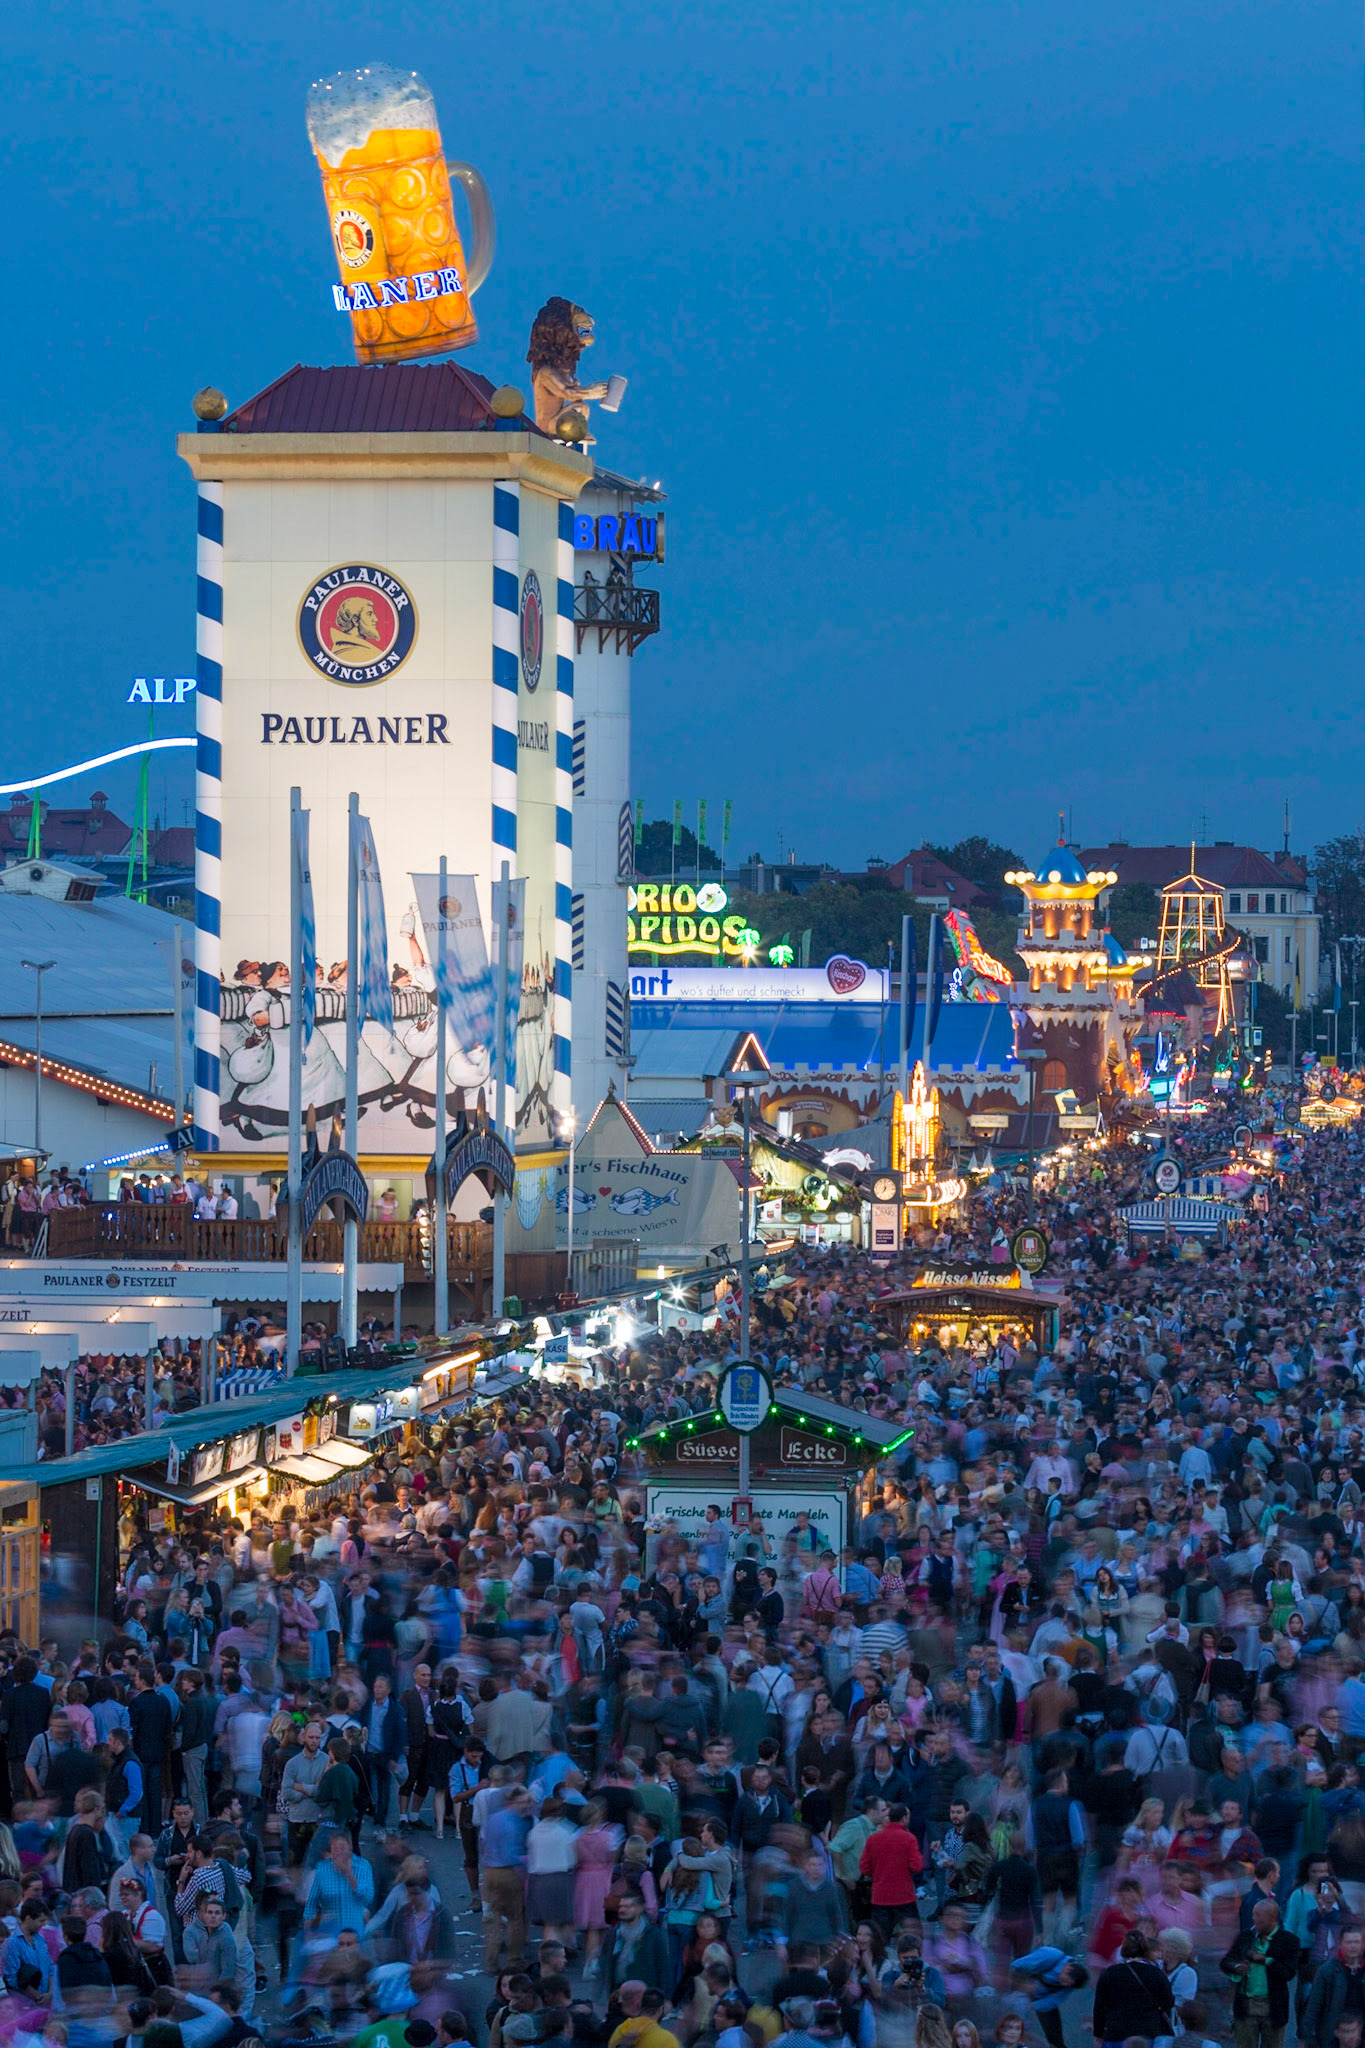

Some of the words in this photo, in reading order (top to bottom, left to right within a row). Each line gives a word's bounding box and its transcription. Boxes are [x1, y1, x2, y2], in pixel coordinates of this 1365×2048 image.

[574, 512, 657, 554] BRÄU
[304, 567, 409, 612] PAULANER
[313, 650, 401, 681] MÜNCHEN
[126, 678, 198, 703] ALP
[261, 713, 452, 745] PAULANER
[636, 883, 697, 913] RIO
[631, 969, 673, 996] art
[680, 985, 703, 997] wo's
[706, 984, 736, 997] duftet
[737, 984, 756, 997] und
[760, 984, 806, 997] schmeckt
[607, 1159, 689, 1185] Fischhaus
[591, 1226, 637, 1237] scheene
[44, 1275, 104, 1287] PAULANER
[123, 1276, 177, 1288] FESTZELT
[922, 1270, 968, 1285] Heisse
[969, 1270, 1011, 1285] Nüsse
[682, 1441, 738, 1458] Süsse
[786, 1442, 838, 1460] Ecke
[664, 1505, 705, 1518] Frische
